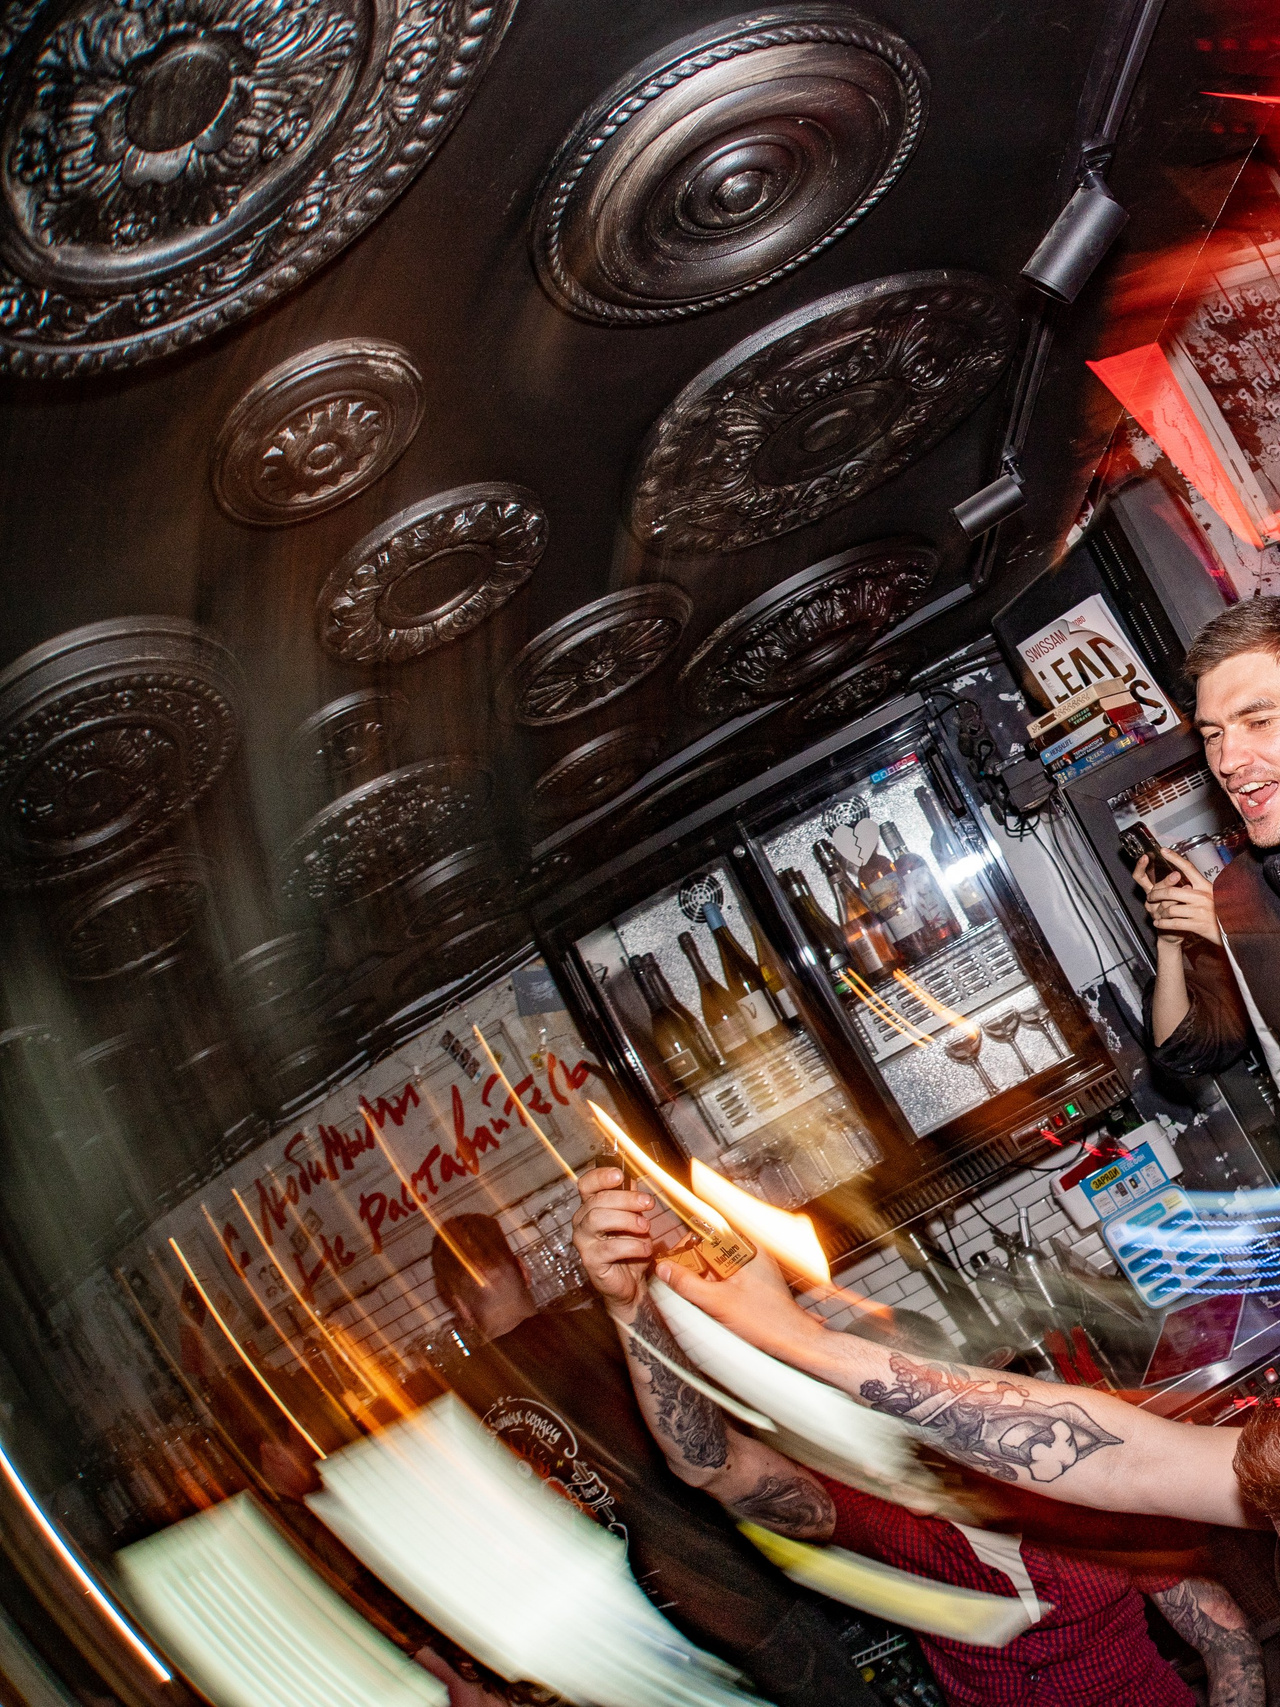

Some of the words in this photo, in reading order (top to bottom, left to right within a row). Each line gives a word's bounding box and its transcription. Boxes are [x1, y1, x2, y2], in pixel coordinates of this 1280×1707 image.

[1092, 1167, 1120, 1190] ЗАРЯДИ
[1120, 1153, 1147, 1173] ТЕЛЕФОН
[714, 1243, 740, 1266] Marlboro
